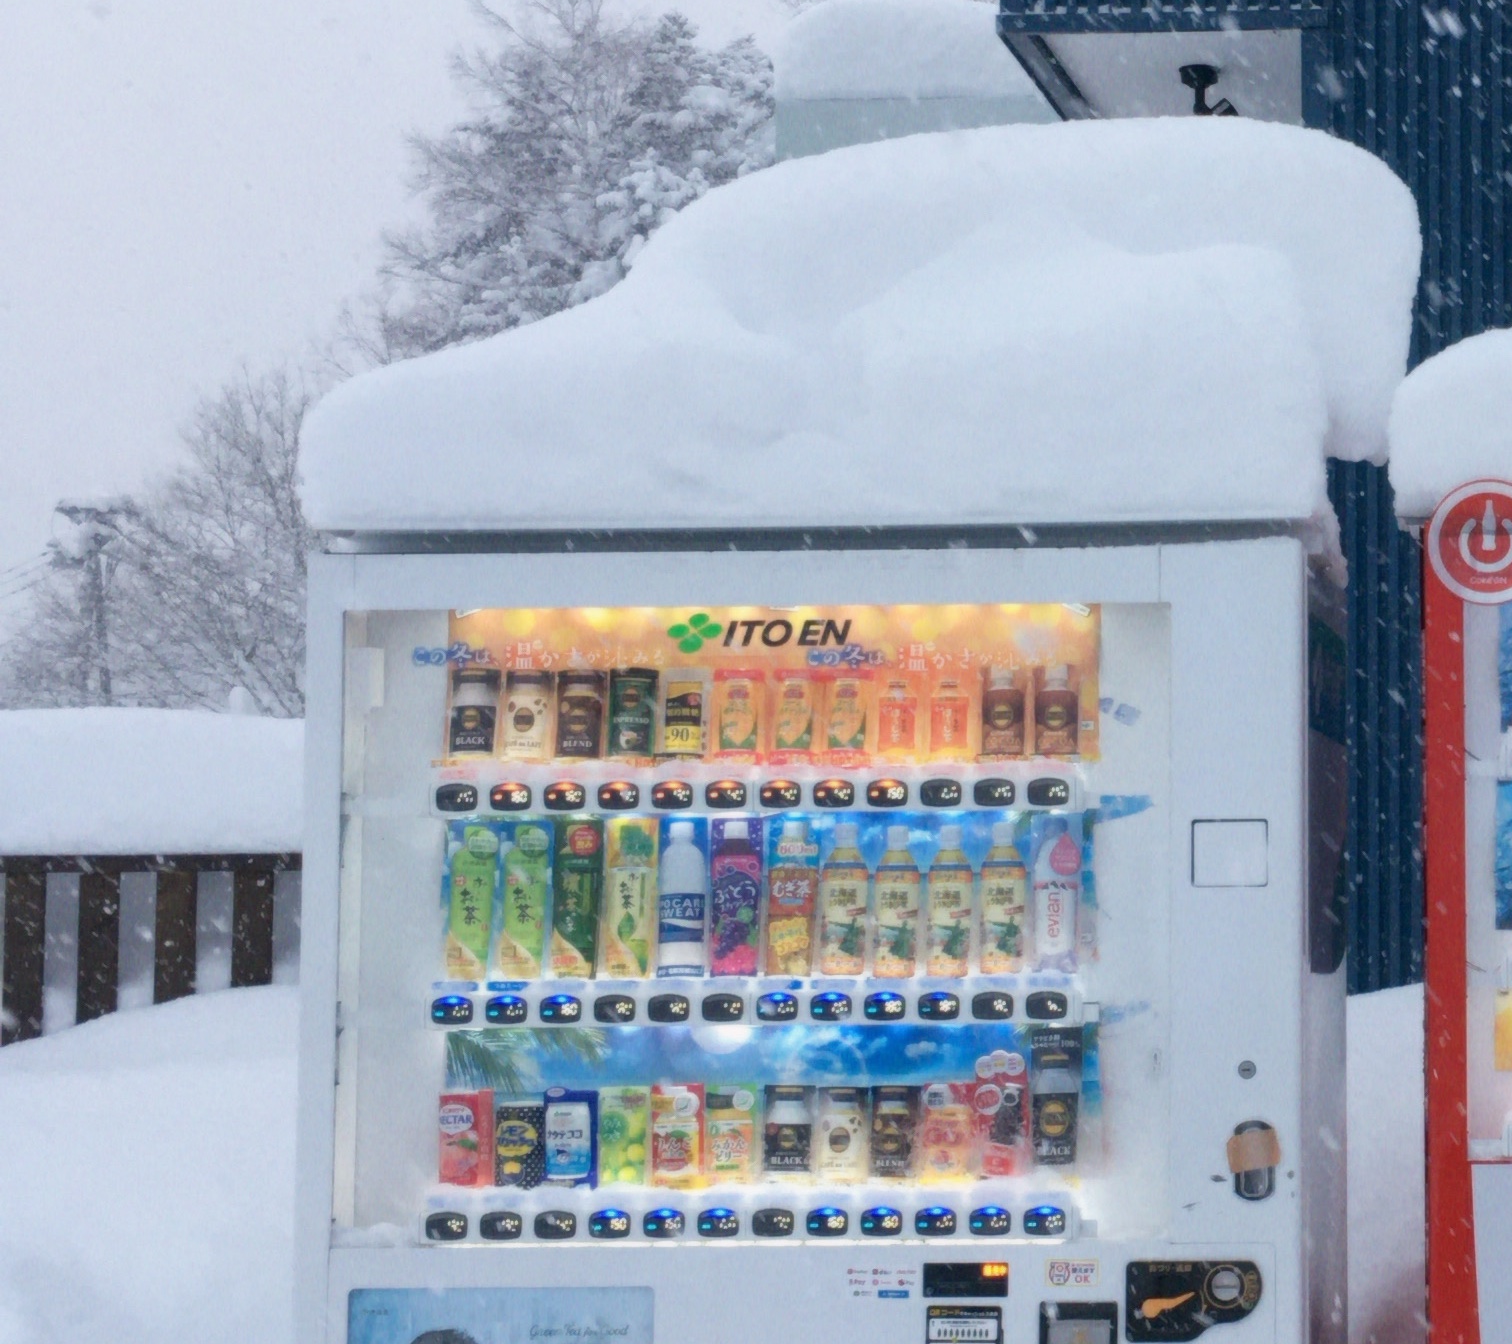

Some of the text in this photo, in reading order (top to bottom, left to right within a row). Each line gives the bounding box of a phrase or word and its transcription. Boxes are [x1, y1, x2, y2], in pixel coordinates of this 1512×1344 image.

[722, 619, 852, 647] ITO EN
[455, 736, 485, 746] BLACK
[671, 728, 690, 742] 90
[562, 740, 593, 748] BLEND
[714, 880, 756, 904] ぶどう
[772, 878, 812, 898] むぎ茶
[1047, 892, 1062, 939] evian
[771, 1156, 804, 1165] BLACK
[1074, 1274, 1091, 1284] OK
